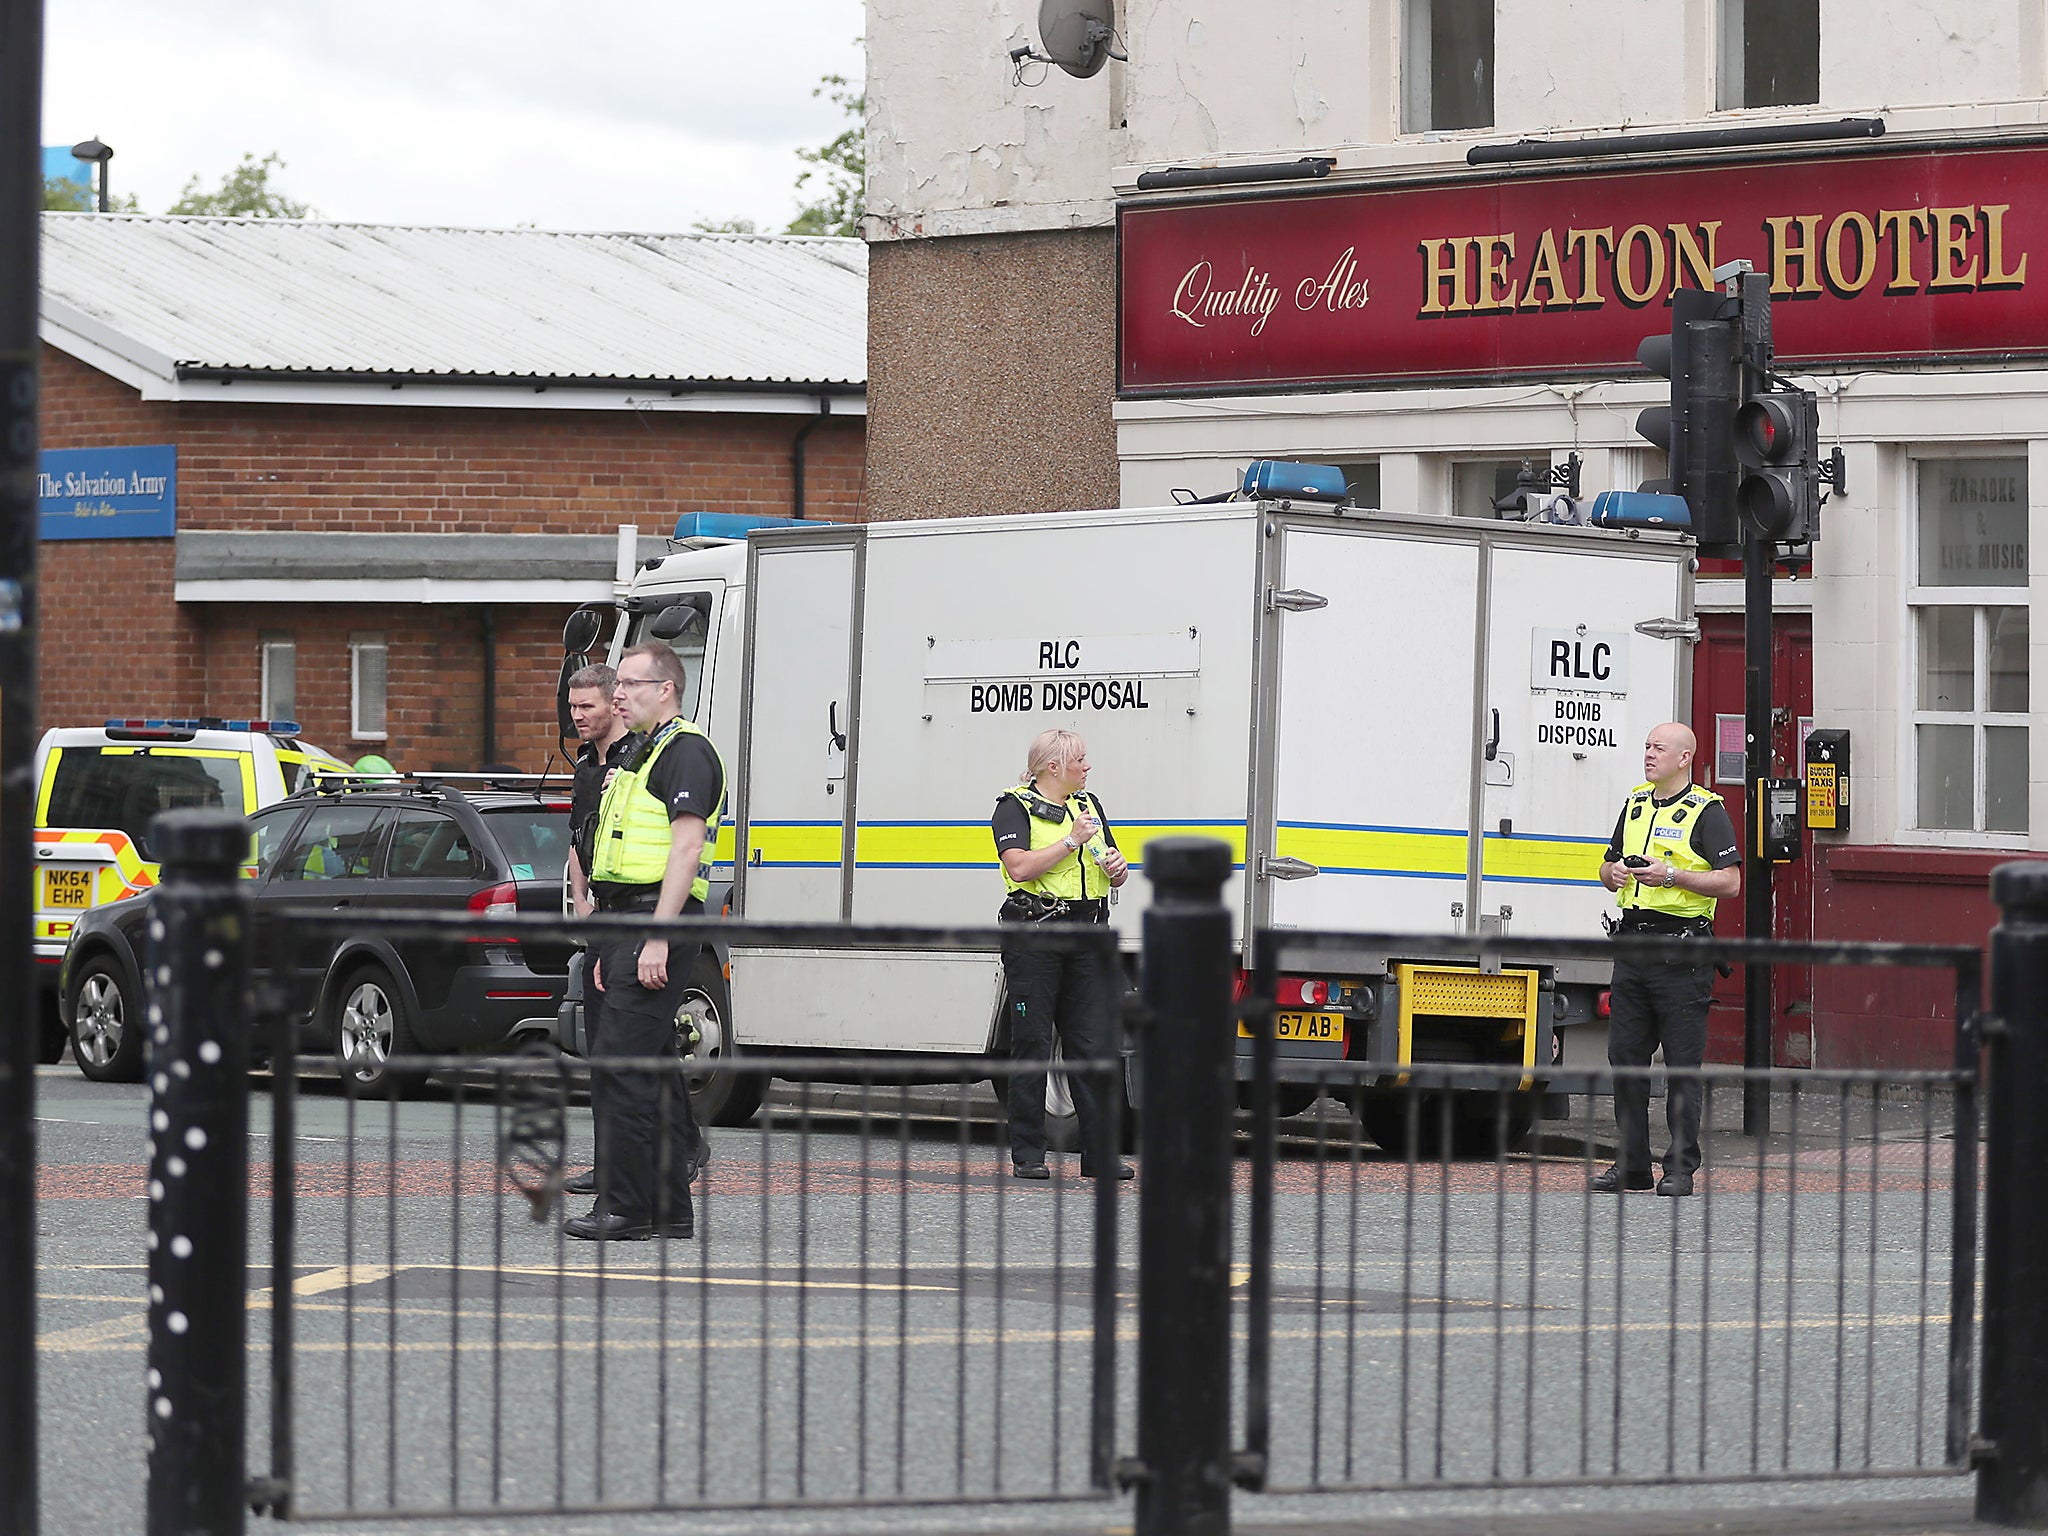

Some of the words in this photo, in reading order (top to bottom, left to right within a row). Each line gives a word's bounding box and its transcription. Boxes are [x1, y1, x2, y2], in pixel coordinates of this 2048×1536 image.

[1417, 220, 1723, 319] HEATON
[1762, 204, 2028, 300] HOTEL
[1169, 260, 1282, 337] Quality
[1295, 246, 1369, 312] Ales
[37, 473, 63, 498] The
[65, 470, 126, 498] Salvation
[128, 469, 167, 501] Army
[1950, 477, 2016, 503] KARAOKE
[1942, 543, 1972, 570] LIVE
[1979, 543, 2024, 570] MUSIC
[1039, 641, 1080, 669] RLC
[1550, 640, 1611, 680] RLC
[971, 684, 1033, 713] BOMB
[1042, 681, 1149, 711] DISPOSAL
[1555, 700, 1601, 722] BOMB
[1538, 724, 1617, 747] DISPOSAL
[1810, 767, 1834, 777] BUDGET
[1810, 778, 1834, 787] TAXIS
[1655, 828, 1681, 838] POLICE
[1719, 845, 1737, 857] POLICE
[48, 870, 90, 887] NK64
[53, 889, 84, 904] EHR
[1279, 1014, 1303, 1036] 67
[1307, 1016, 1331, 1037] AB
